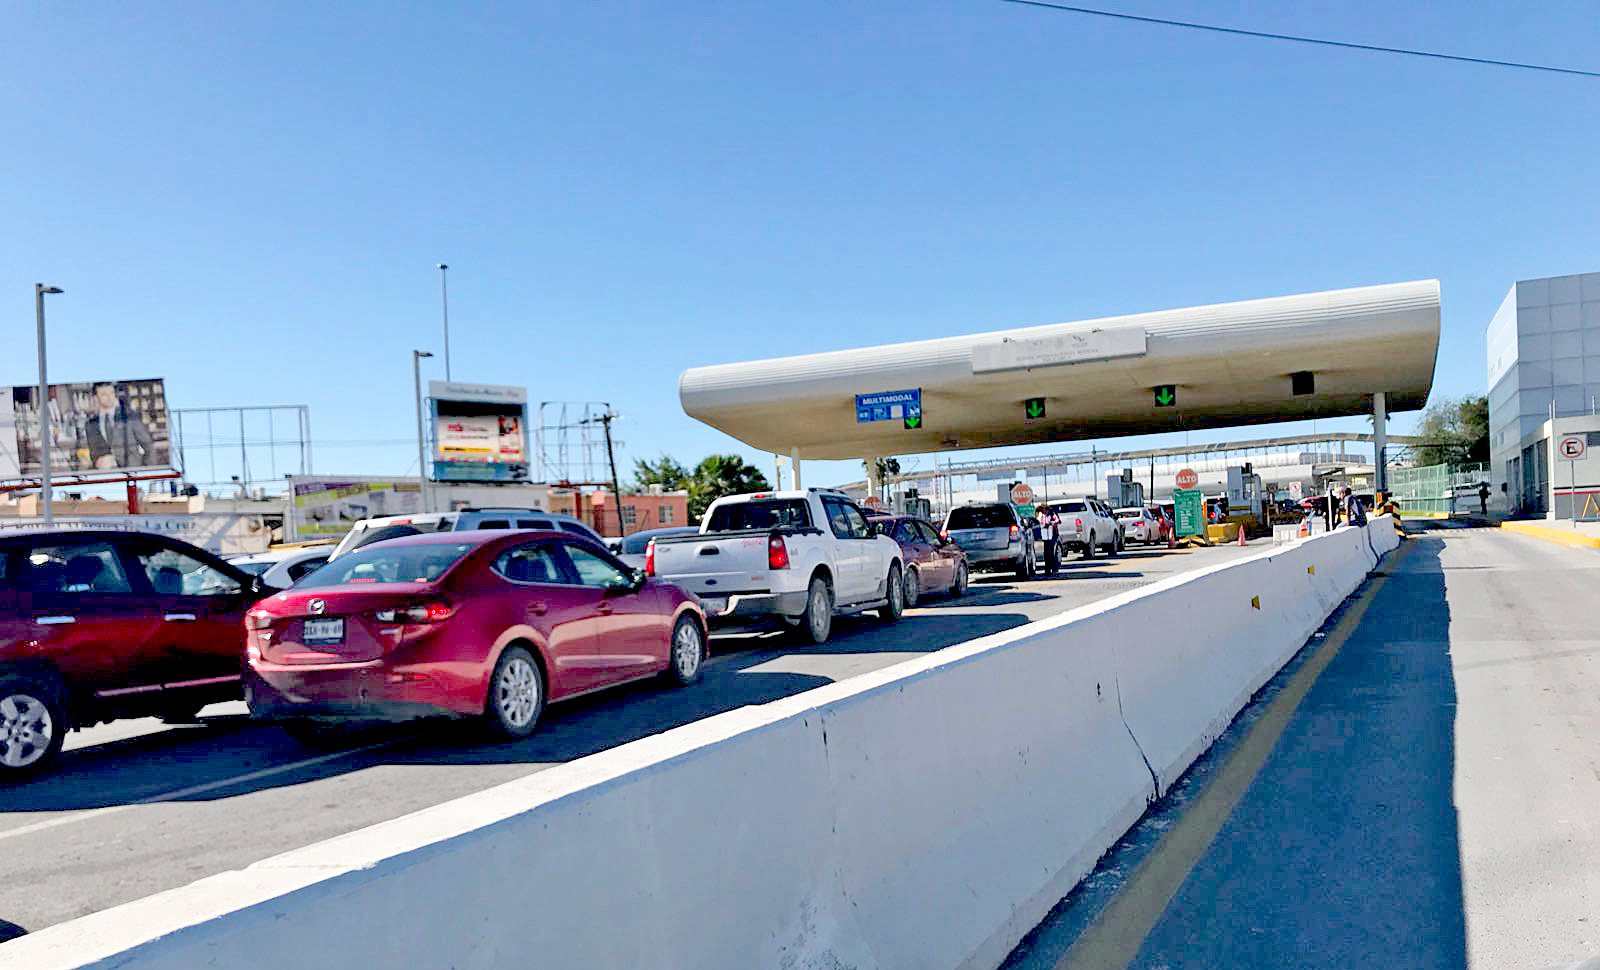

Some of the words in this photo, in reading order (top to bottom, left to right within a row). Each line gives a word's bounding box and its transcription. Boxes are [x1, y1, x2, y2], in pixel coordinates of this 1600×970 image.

[863, 393, 912, 405] MULTIMODAL
[1567, 441, 1578, 454] E
[1176, 475, 1196, 483] ALTO
